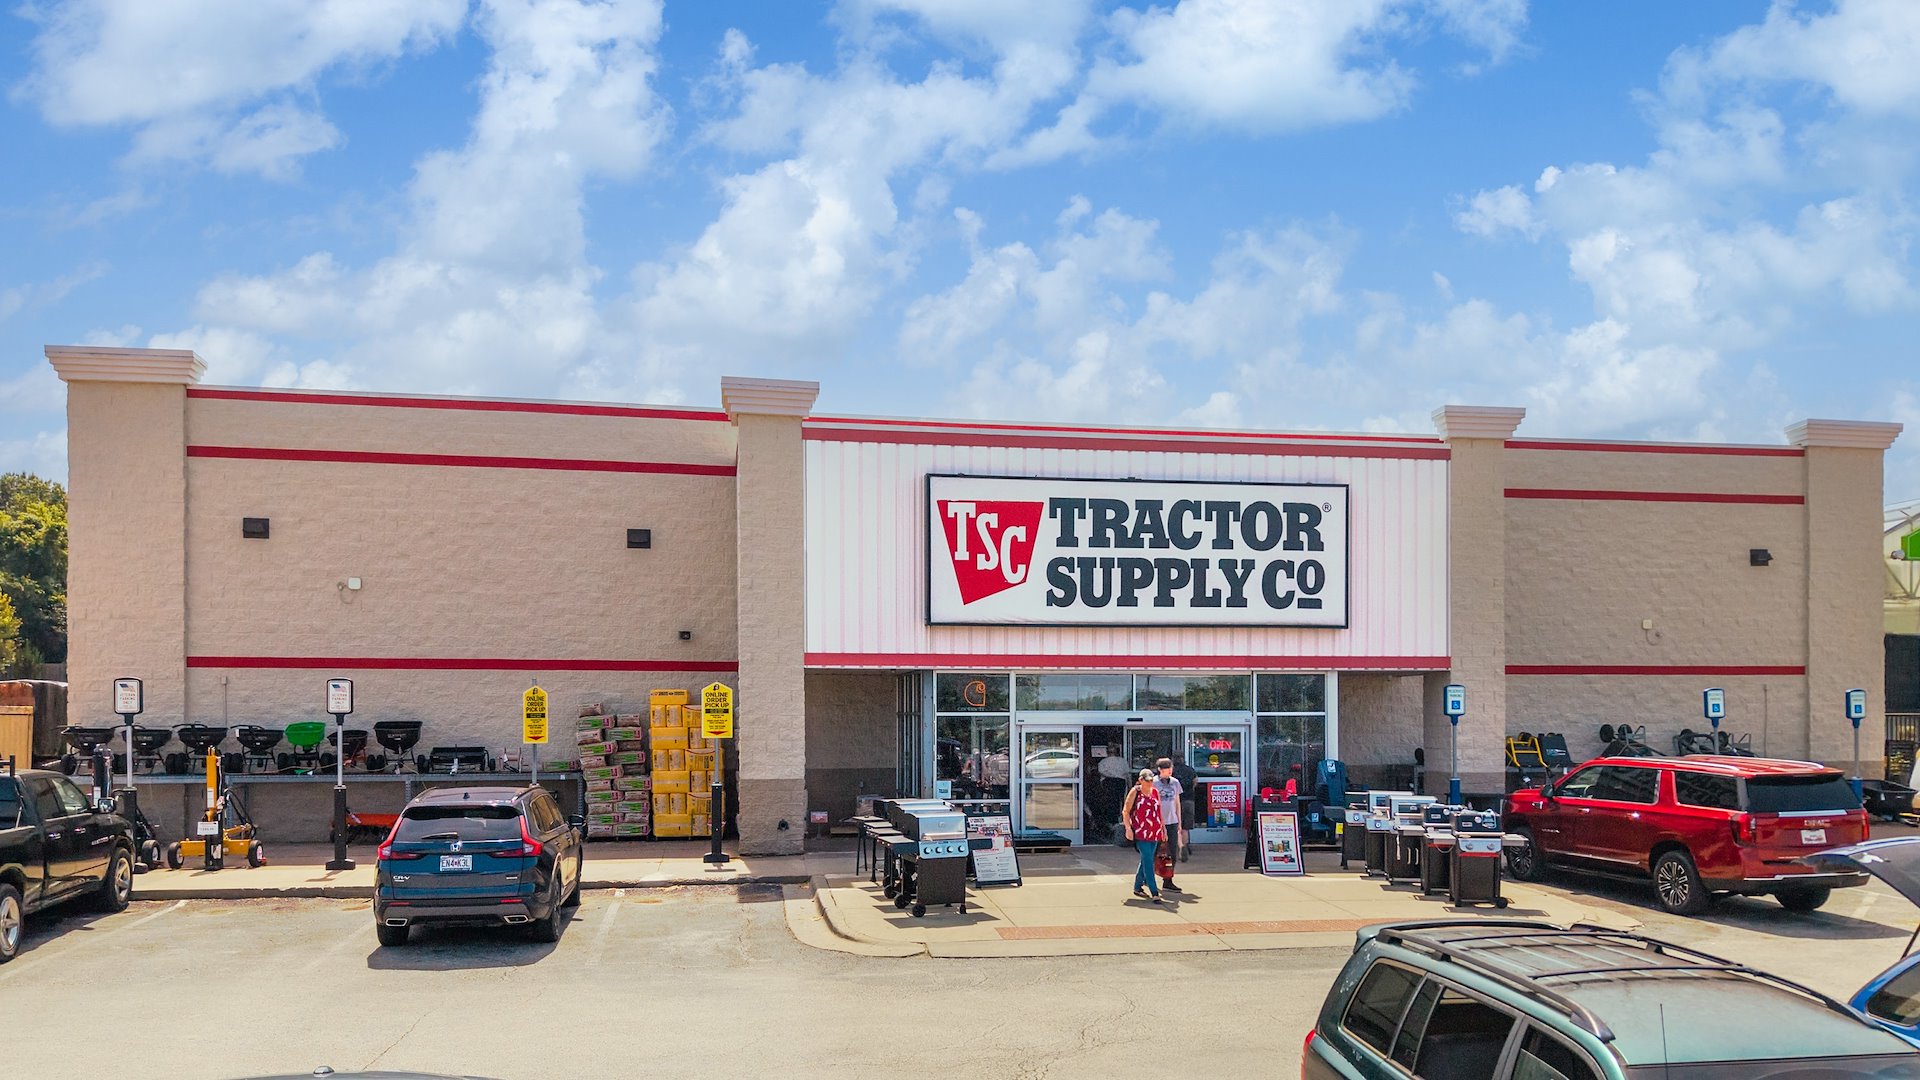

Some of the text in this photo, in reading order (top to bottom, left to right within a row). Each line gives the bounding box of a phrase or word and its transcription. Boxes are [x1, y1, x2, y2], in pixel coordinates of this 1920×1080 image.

[947, 502, 1027, 584] TSC
[1049, 497, 1324, 552] TRACTOR
[1046, 556, 1255, 608] SUPPLY
[1209, 740, 1232, 750] OPEN
